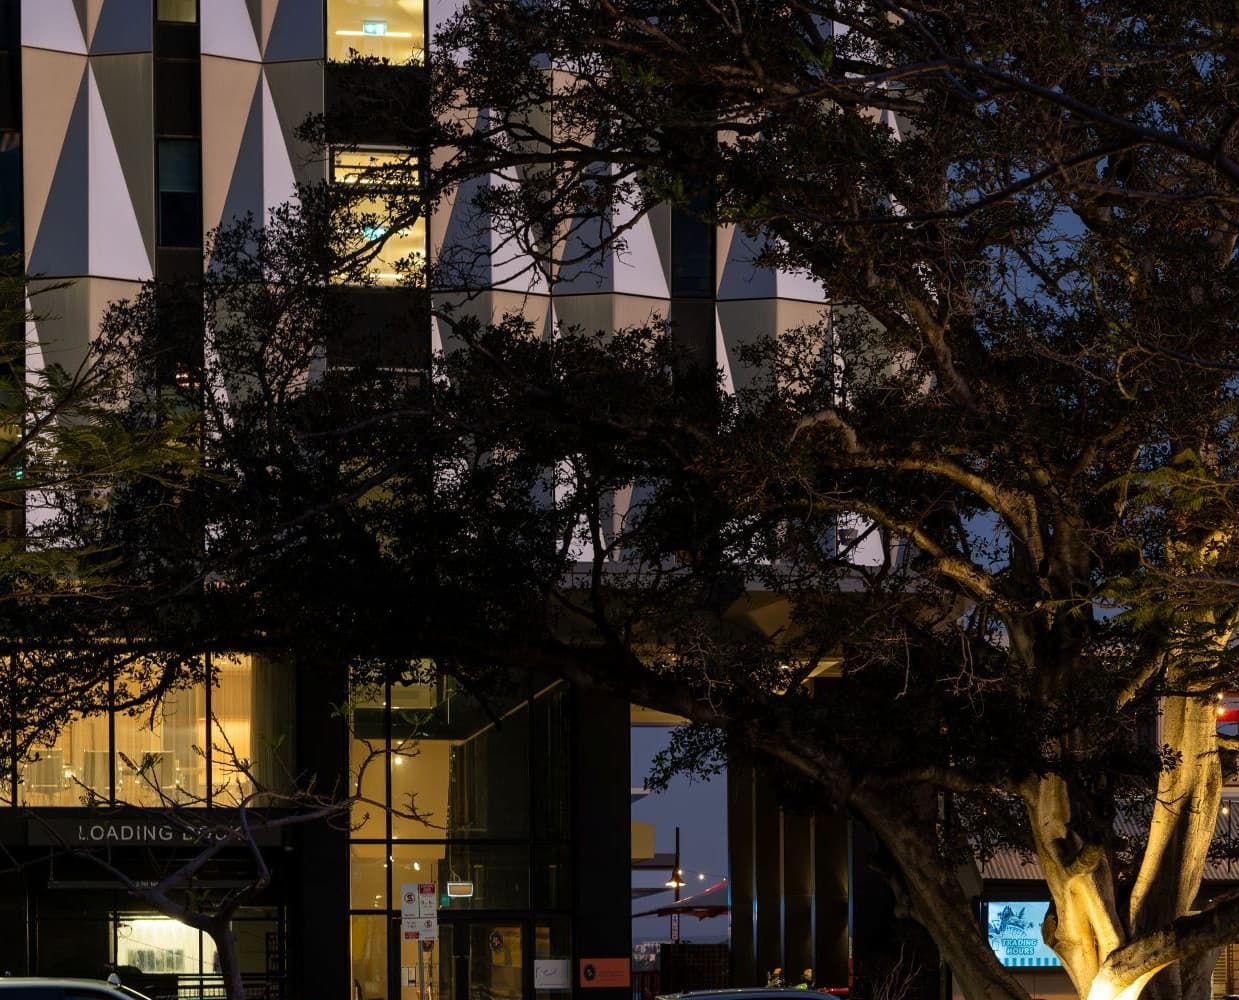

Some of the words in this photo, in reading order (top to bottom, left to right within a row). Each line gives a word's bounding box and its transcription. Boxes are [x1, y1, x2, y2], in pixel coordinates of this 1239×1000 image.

[78, 825, 174, 841] LOADING
[1002, 938, 1037, 946] TRADING
[1006, 946, 1034, 955] HOURS
